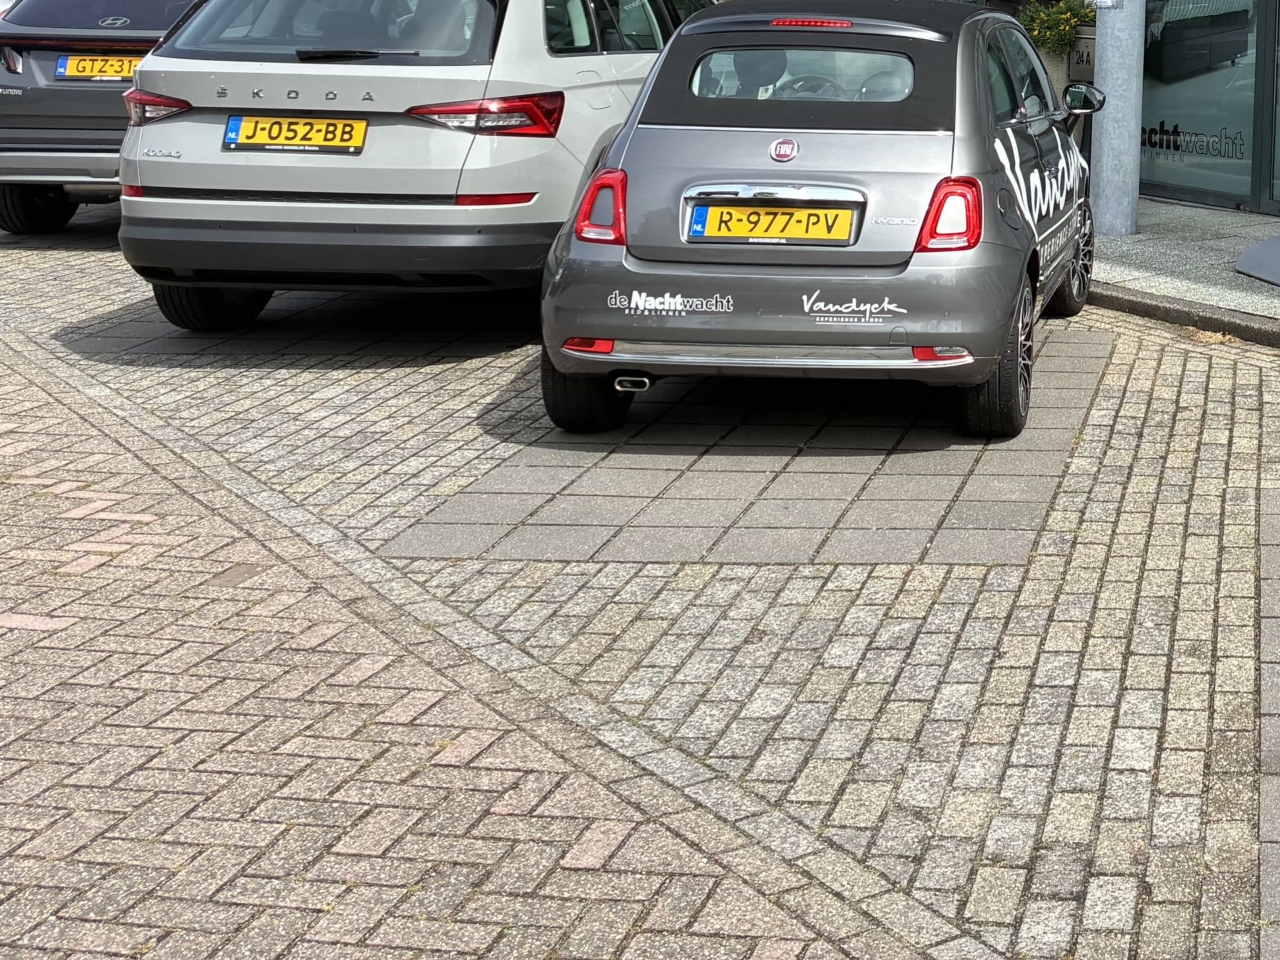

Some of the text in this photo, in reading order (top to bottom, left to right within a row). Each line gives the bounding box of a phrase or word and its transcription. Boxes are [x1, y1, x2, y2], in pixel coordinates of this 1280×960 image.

[1075, 50, 1091, 65] 24 A
[76, 58, 137, 74] GTZ-31-
[227, 131, 238, 139] NL
[245, 121, 355, 142] J-052-BB
[1141, 120, 1245, 160] achtwacht
[142, 148, 182, 159] KODIAQ
[776, 144, 793, 155] FIAT
[693, 223, 703, 231] NL
[717, 211, 840, 235] R-977-PV
[871, 217, 919, 226] HYBRID
[608, 290, 734, 312] de Nachtwacht
[802, 289, 908, 323] Vandyck
